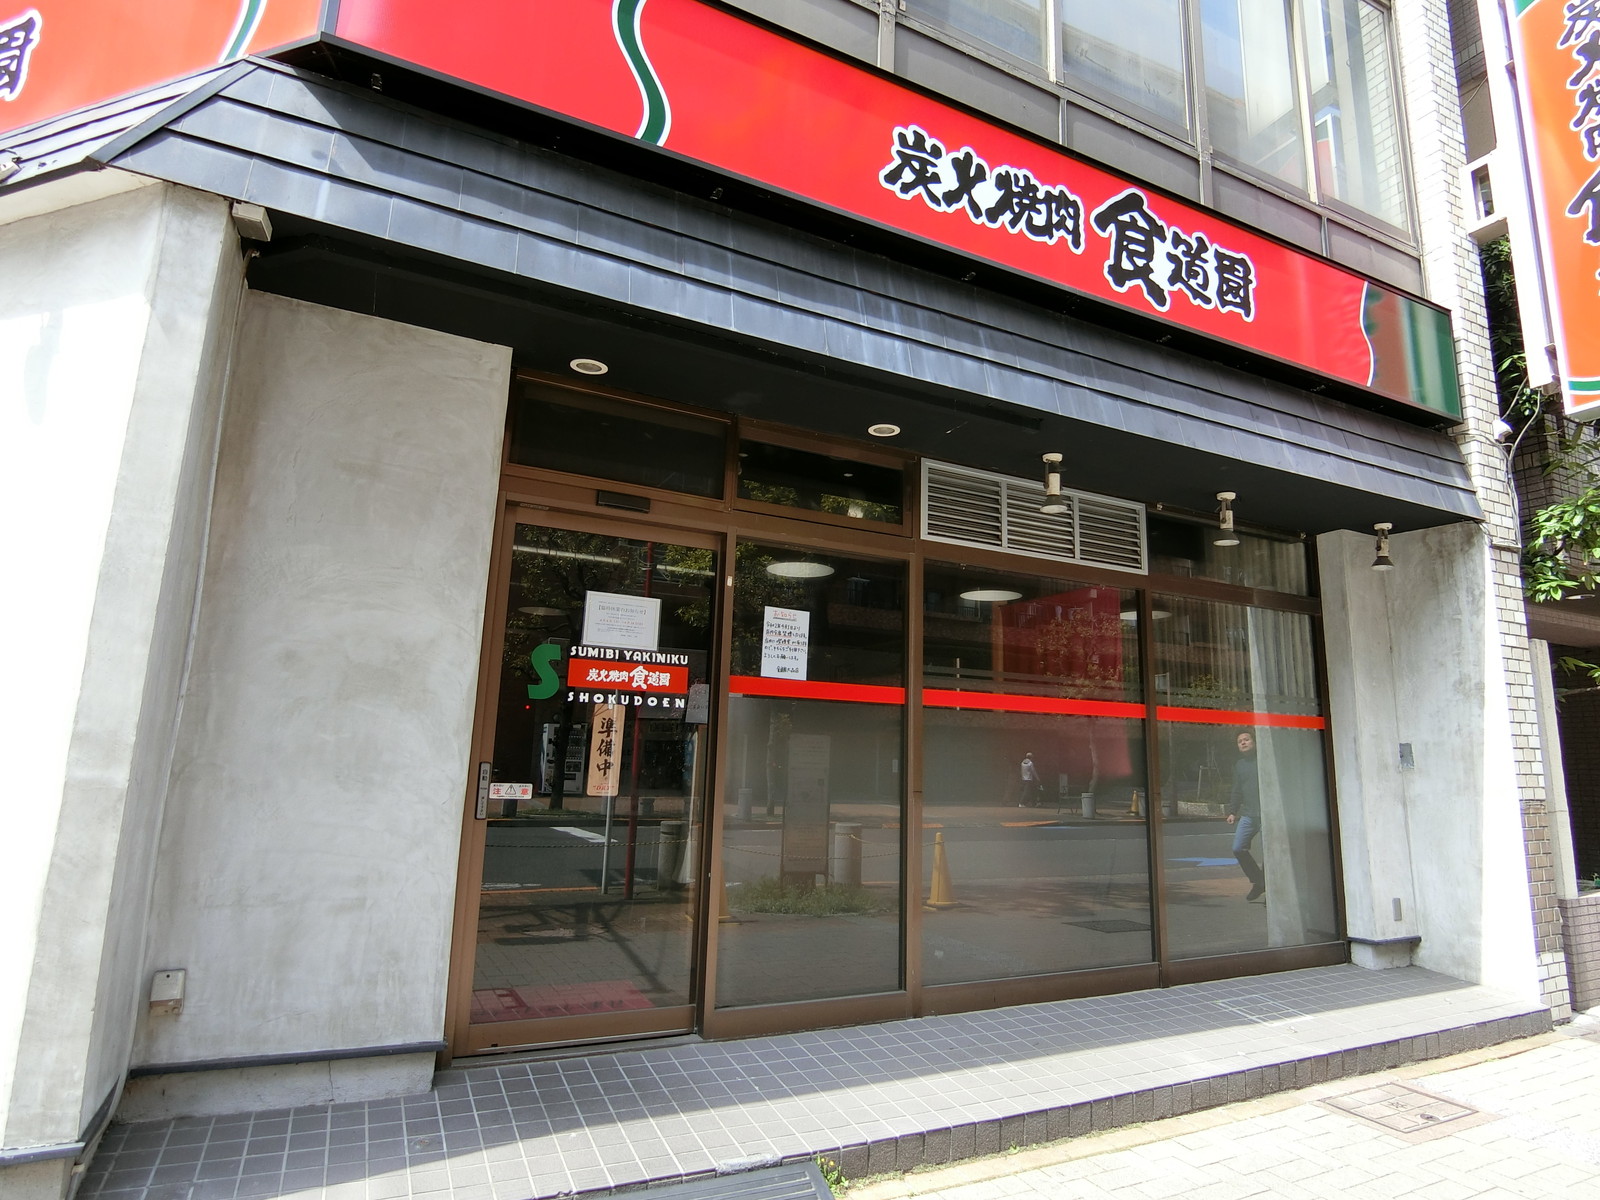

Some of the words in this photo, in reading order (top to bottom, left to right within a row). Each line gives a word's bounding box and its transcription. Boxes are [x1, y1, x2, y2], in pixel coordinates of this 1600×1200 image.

[884, 129, 1082, 250] 炭火焼肉
[1093, 192, 1253, 318] 食道園
[570, 645, 618, 660] SUMIBI
[623, 650, 689, 665] YAKINIKU
[586, 668, 629, 683] 炭火焼肉
[629, 665, 671, 690] 食道園
[567, 691, 686, 709] SHOKUDOEN
[596, 717, 618, 777] 準備中
